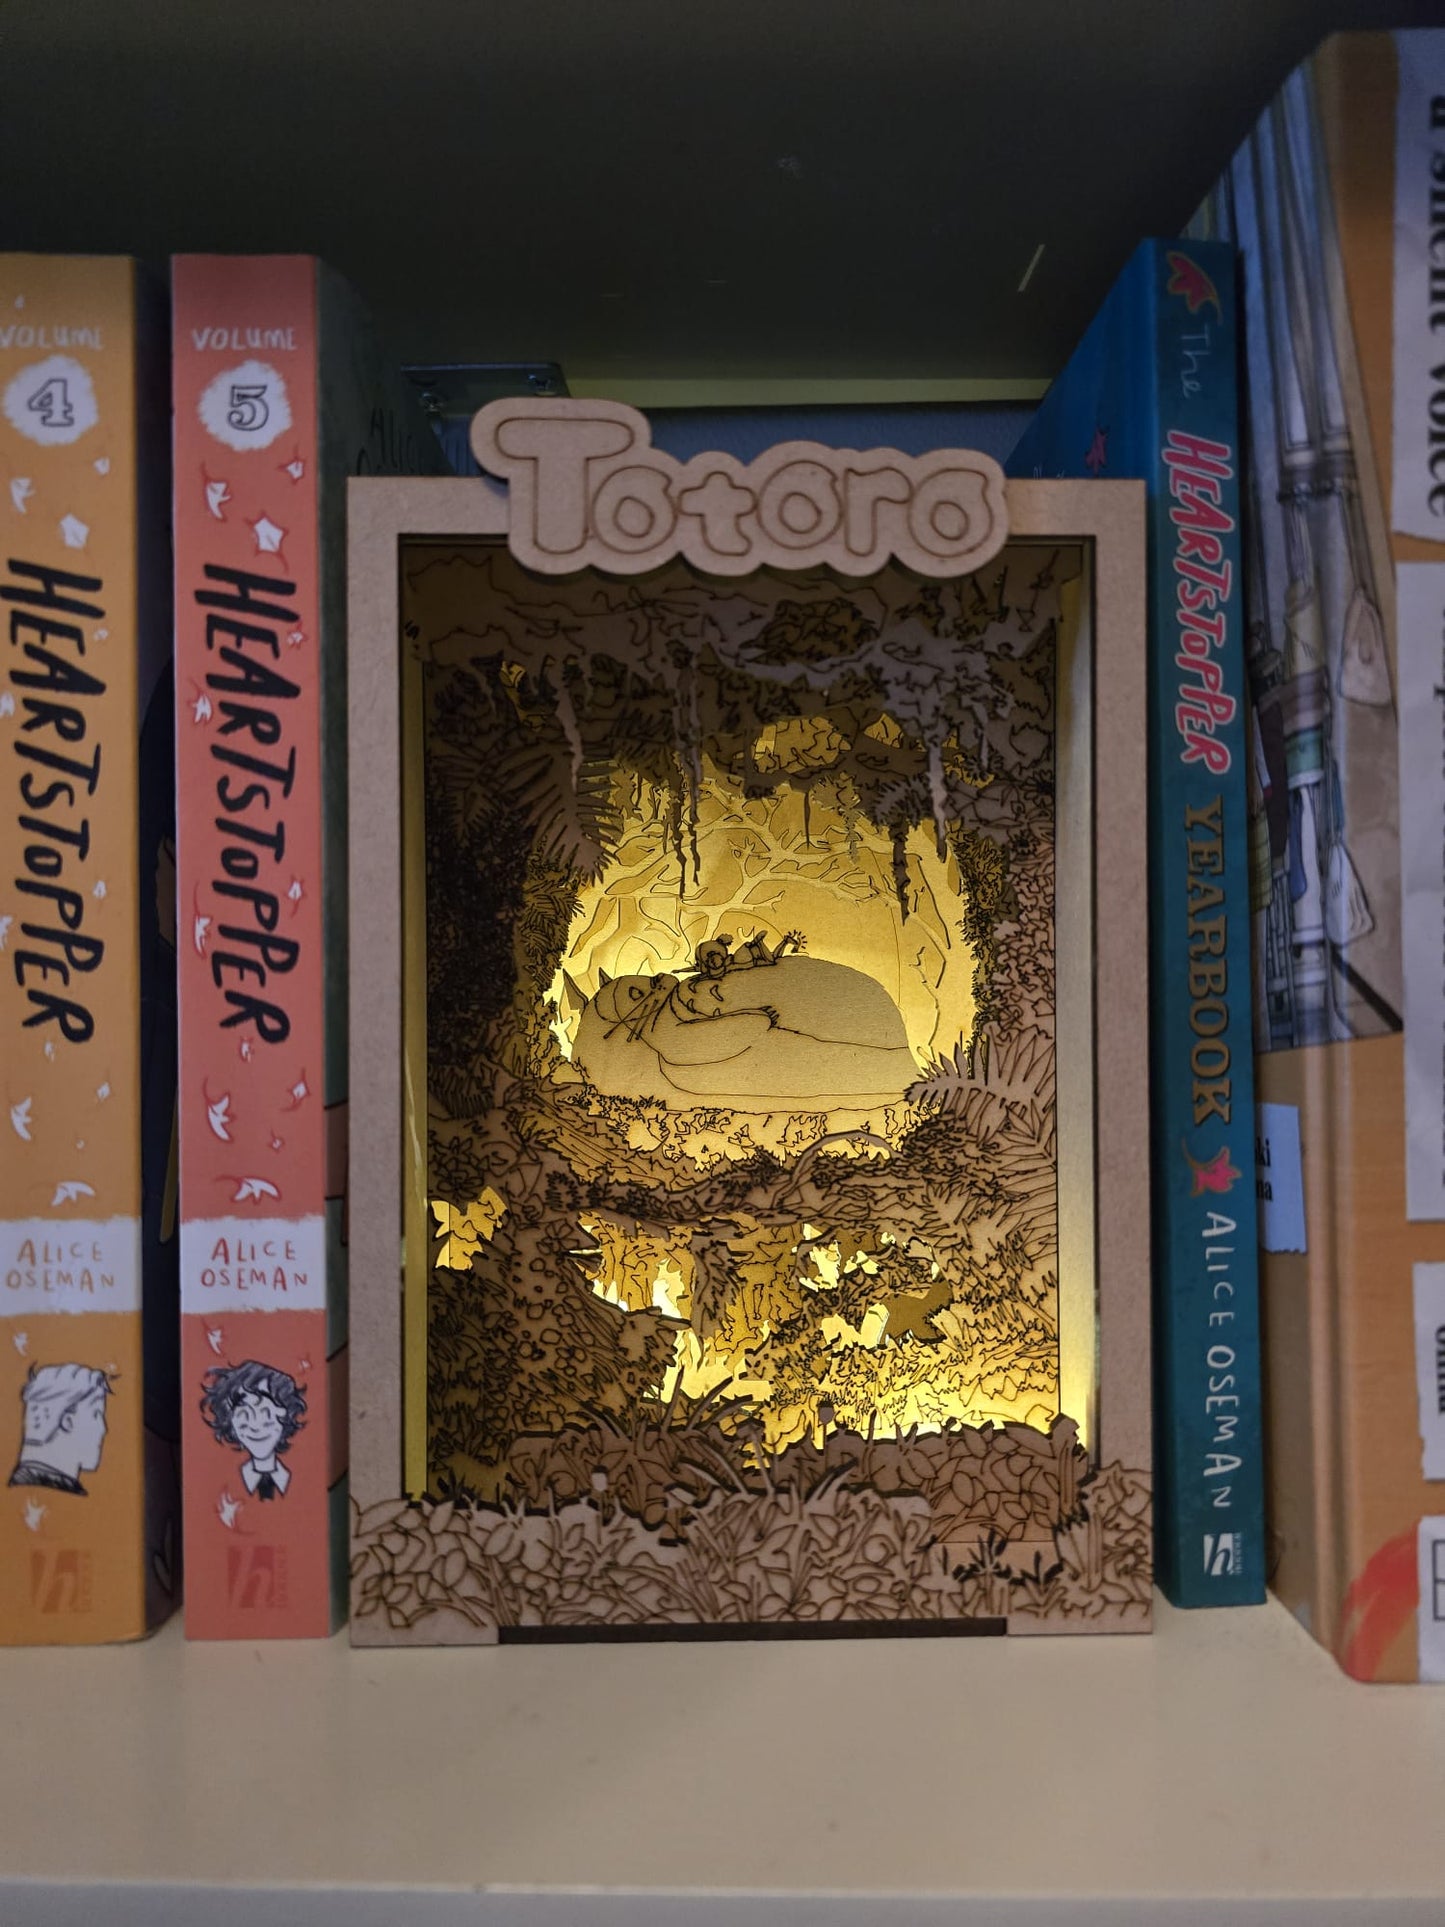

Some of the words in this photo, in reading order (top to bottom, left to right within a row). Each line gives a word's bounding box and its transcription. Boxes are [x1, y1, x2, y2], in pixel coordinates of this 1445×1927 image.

[0, 325, 104, 350] VOLUME
[191, 326, 299, 351] VOLUME
[1179, 323, 1212, 398] The
[27, 378, 75, 428] 4
[226, 384, 270, 432] 5
[493, 415, 996, 560] Totoro
[1162, 430, 1237, 775] HEARTSTOPPER
[0, 558, 107, 1045] HEARTSTOPPER
[194, 563, 301, 1045] HEARTSTOPPER
[1184, 794, 1233, 1126] YEARBOOK
[6, 1267, 115, 1295] OSEMAN
[17, 1239, 104, 1265] ALICE
[200, 1266, 309, 1292] OSEMAN
[211, 1238, 297, 1263] ALICE
[1201, 1210, 1238, 1328] ALICE
[1203, 1344, 1242, 1509] OSEMAN
